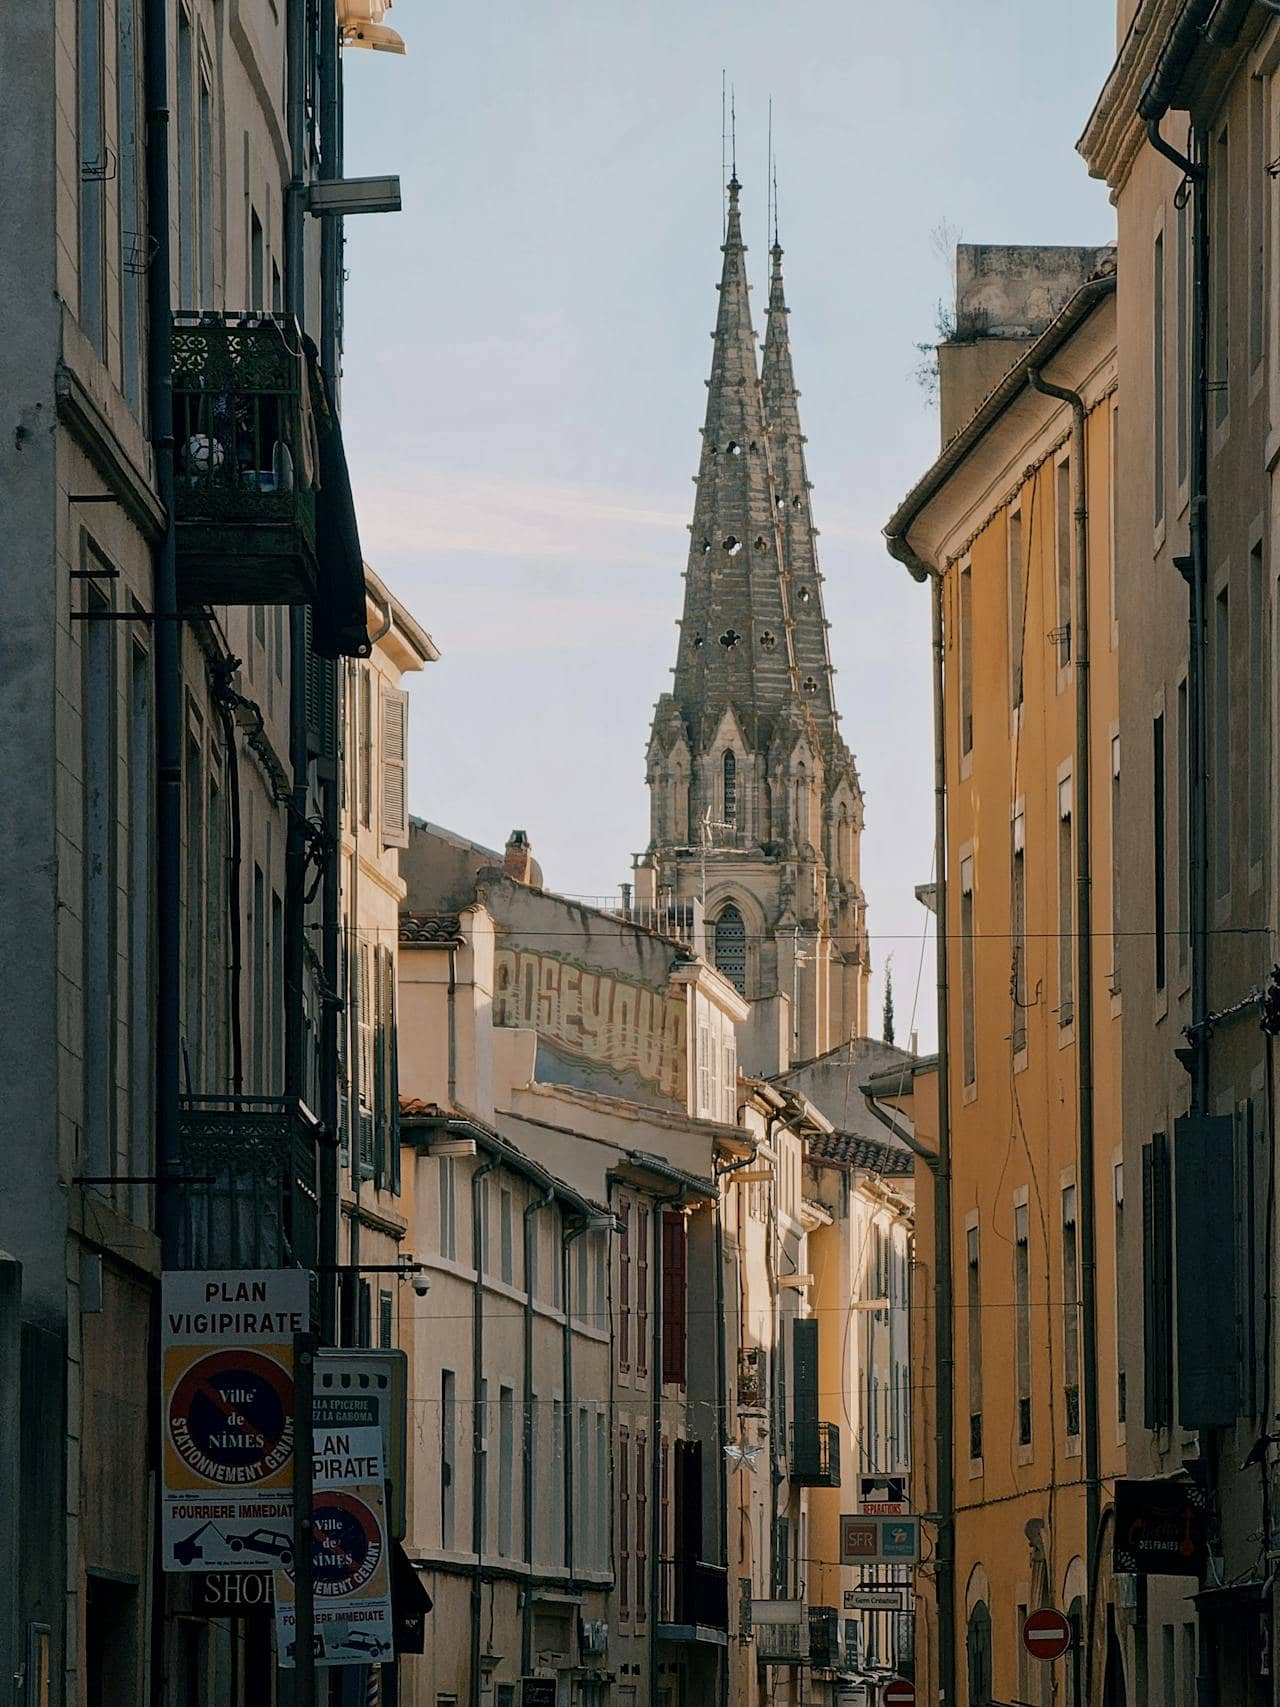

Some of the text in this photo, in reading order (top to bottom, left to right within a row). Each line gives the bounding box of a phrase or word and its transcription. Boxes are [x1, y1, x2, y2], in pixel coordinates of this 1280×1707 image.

[205, 1282, 266, 1302] PLAN
[169, 1312, 302, 1334] VIGIPIRATE
[219, 1389, 254, 1403] Ville
[227, 1412, 245, 1426] de
[323, 1411, 334, 1421] LA
[171, 1416, 263, 1482] STATIONNEMENT
[312, 1434, 350, 1456] LAN
[312, 1456, 379, 1480] PIRATE
[172, 1503, 295, 1519] FOURRIERE IMMEDIAT
[315, 1519, 343, 1531] Ville
[322, 1537, 338, 1549] de
[849, 1532, 873, 1547] SFR
